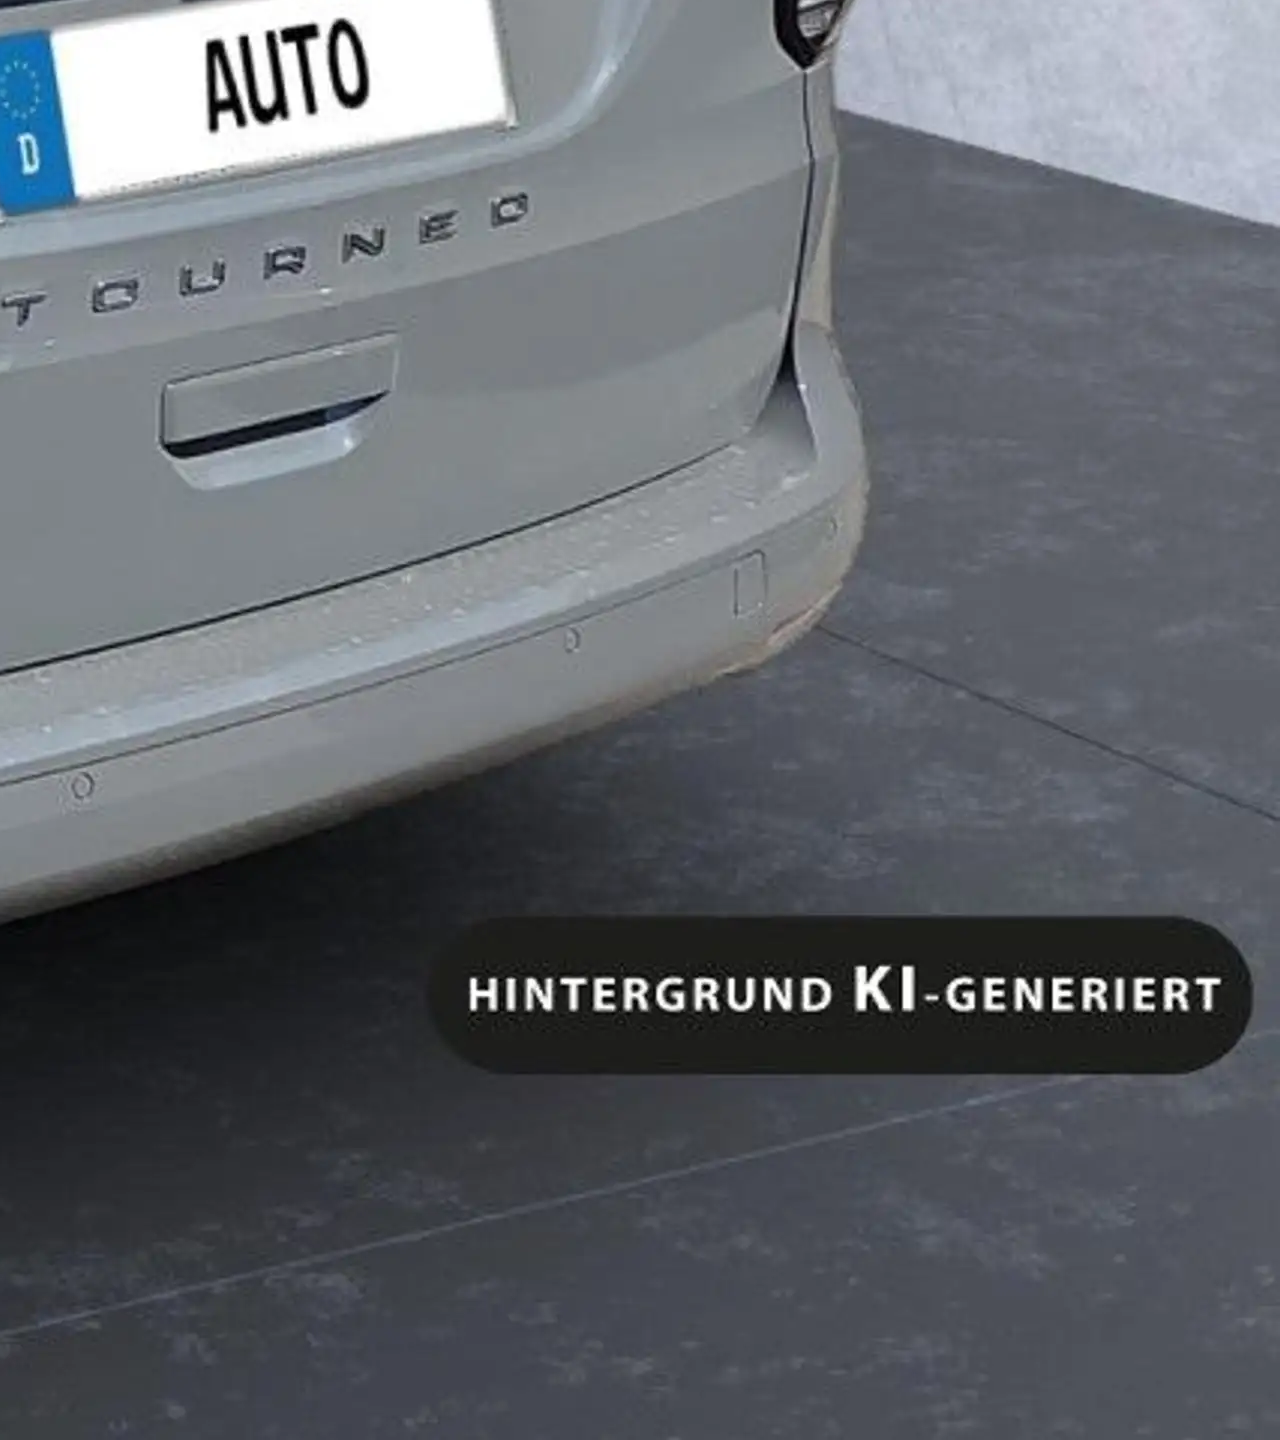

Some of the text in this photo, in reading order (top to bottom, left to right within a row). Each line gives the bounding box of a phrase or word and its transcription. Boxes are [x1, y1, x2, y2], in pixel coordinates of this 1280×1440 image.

[204, 17, 371, 134] AUTO
[17, 132, 41, 176] D
[0, 191, 529, 328] TOURNEO
